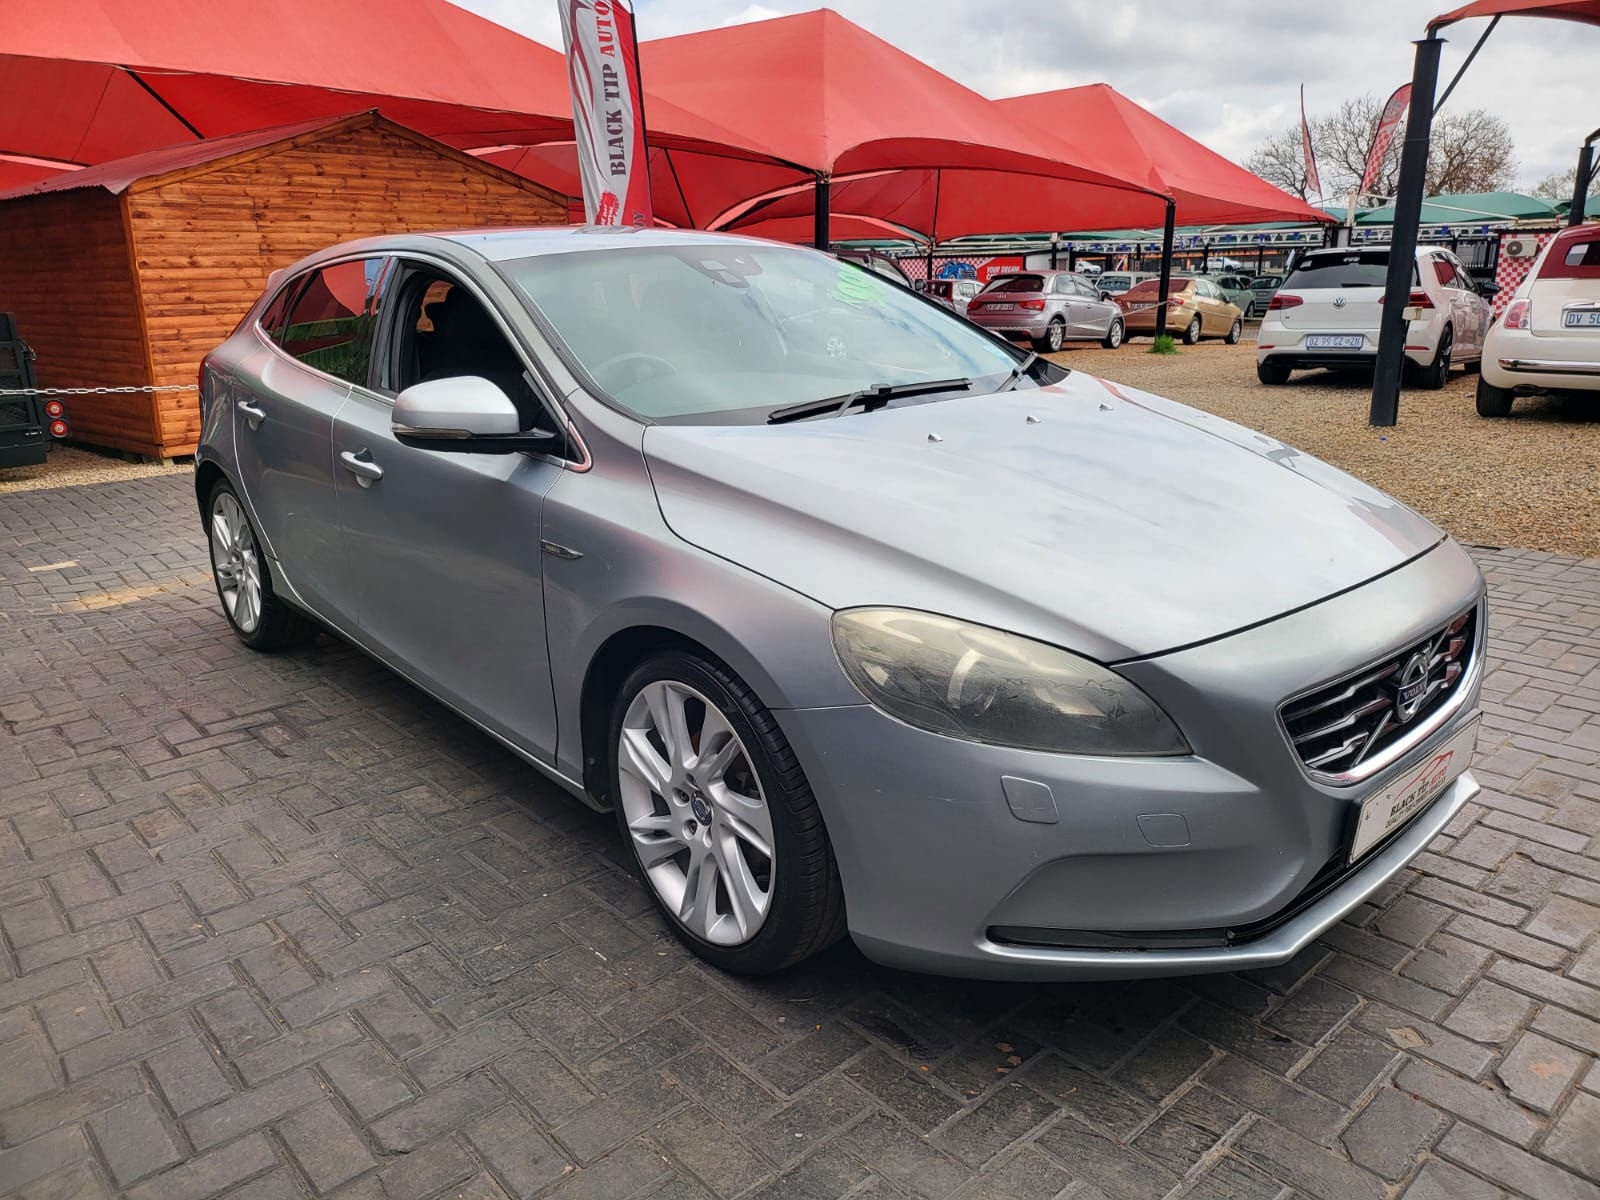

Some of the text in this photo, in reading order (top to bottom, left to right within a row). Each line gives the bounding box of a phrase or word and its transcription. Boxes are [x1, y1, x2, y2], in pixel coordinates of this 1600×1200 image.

[593, 1, 627, 176] BLACK TIP AUTO
[1567, 313, 1583, 324] DV
[1390, 791, 1417, 817] BLACK
[1415, 781, 1430, 797] TIP
